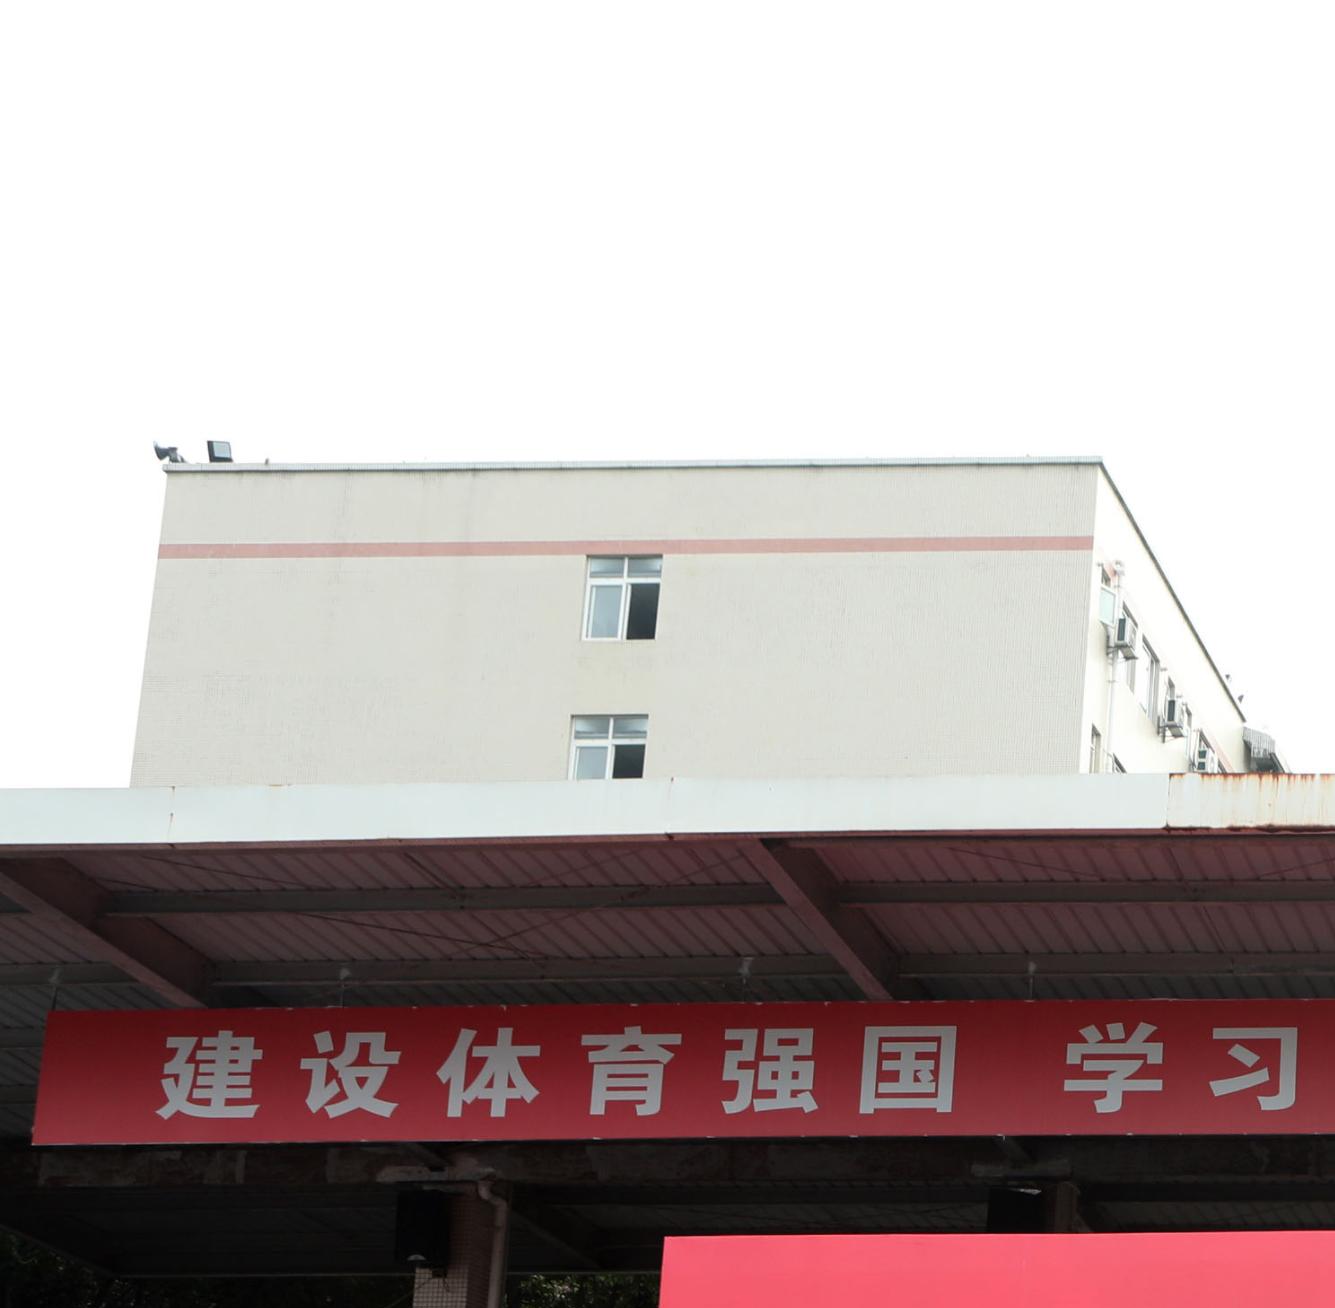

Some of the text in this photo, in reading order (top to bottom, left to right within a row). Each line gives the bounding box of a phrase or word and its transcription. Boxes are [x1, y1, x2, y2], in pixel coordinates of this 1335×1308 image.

[157, 1023, 958, 1120] 建设体育强国
